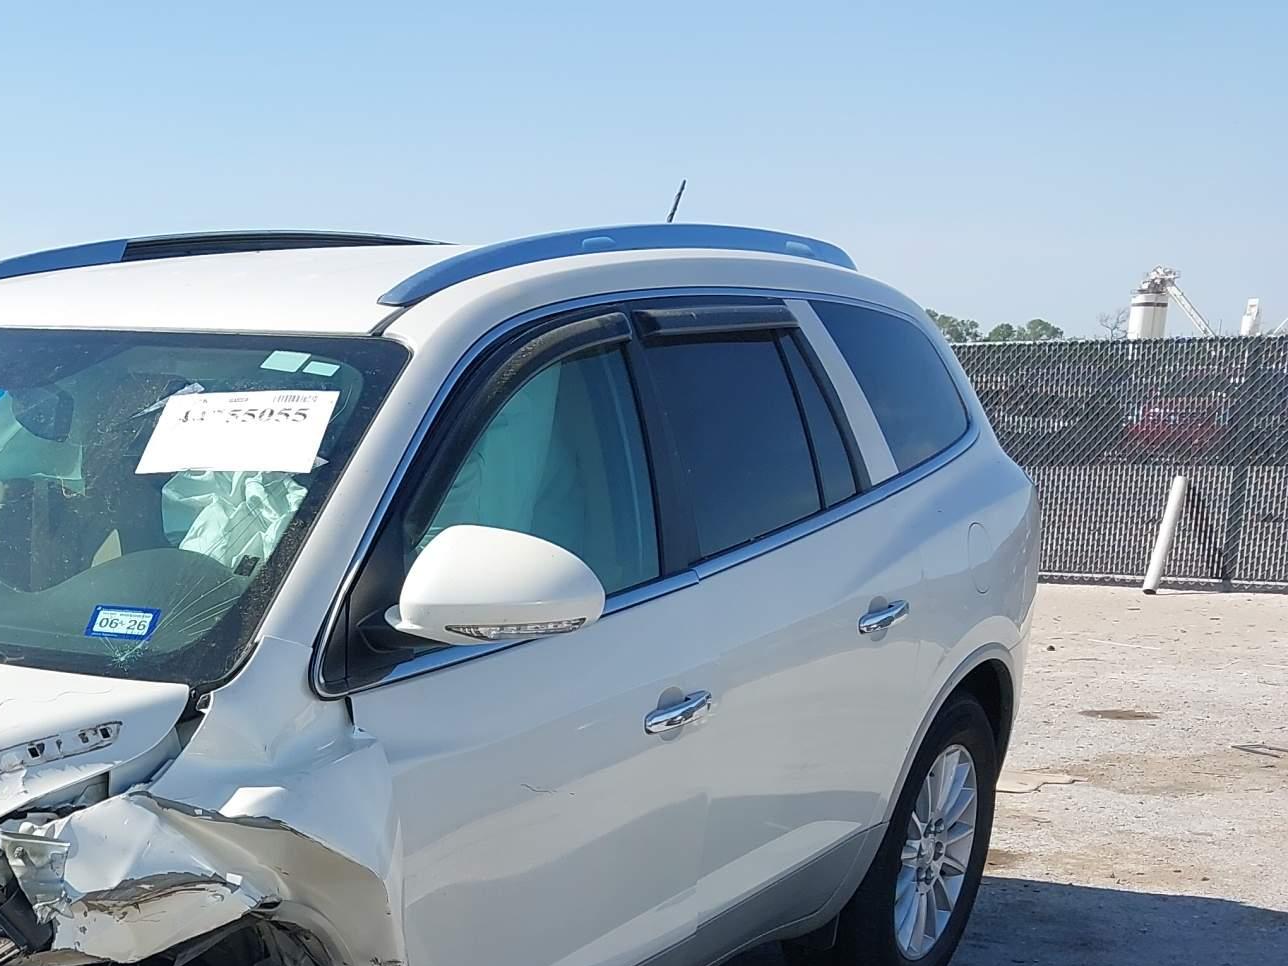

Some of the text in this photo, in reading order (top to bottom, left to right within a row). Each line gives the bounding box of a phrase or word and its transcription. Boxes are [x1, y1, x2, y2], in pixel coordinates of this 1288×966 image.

[178, 408, 310, 424] 55055
[98, 617, 148, 631] 06 26
